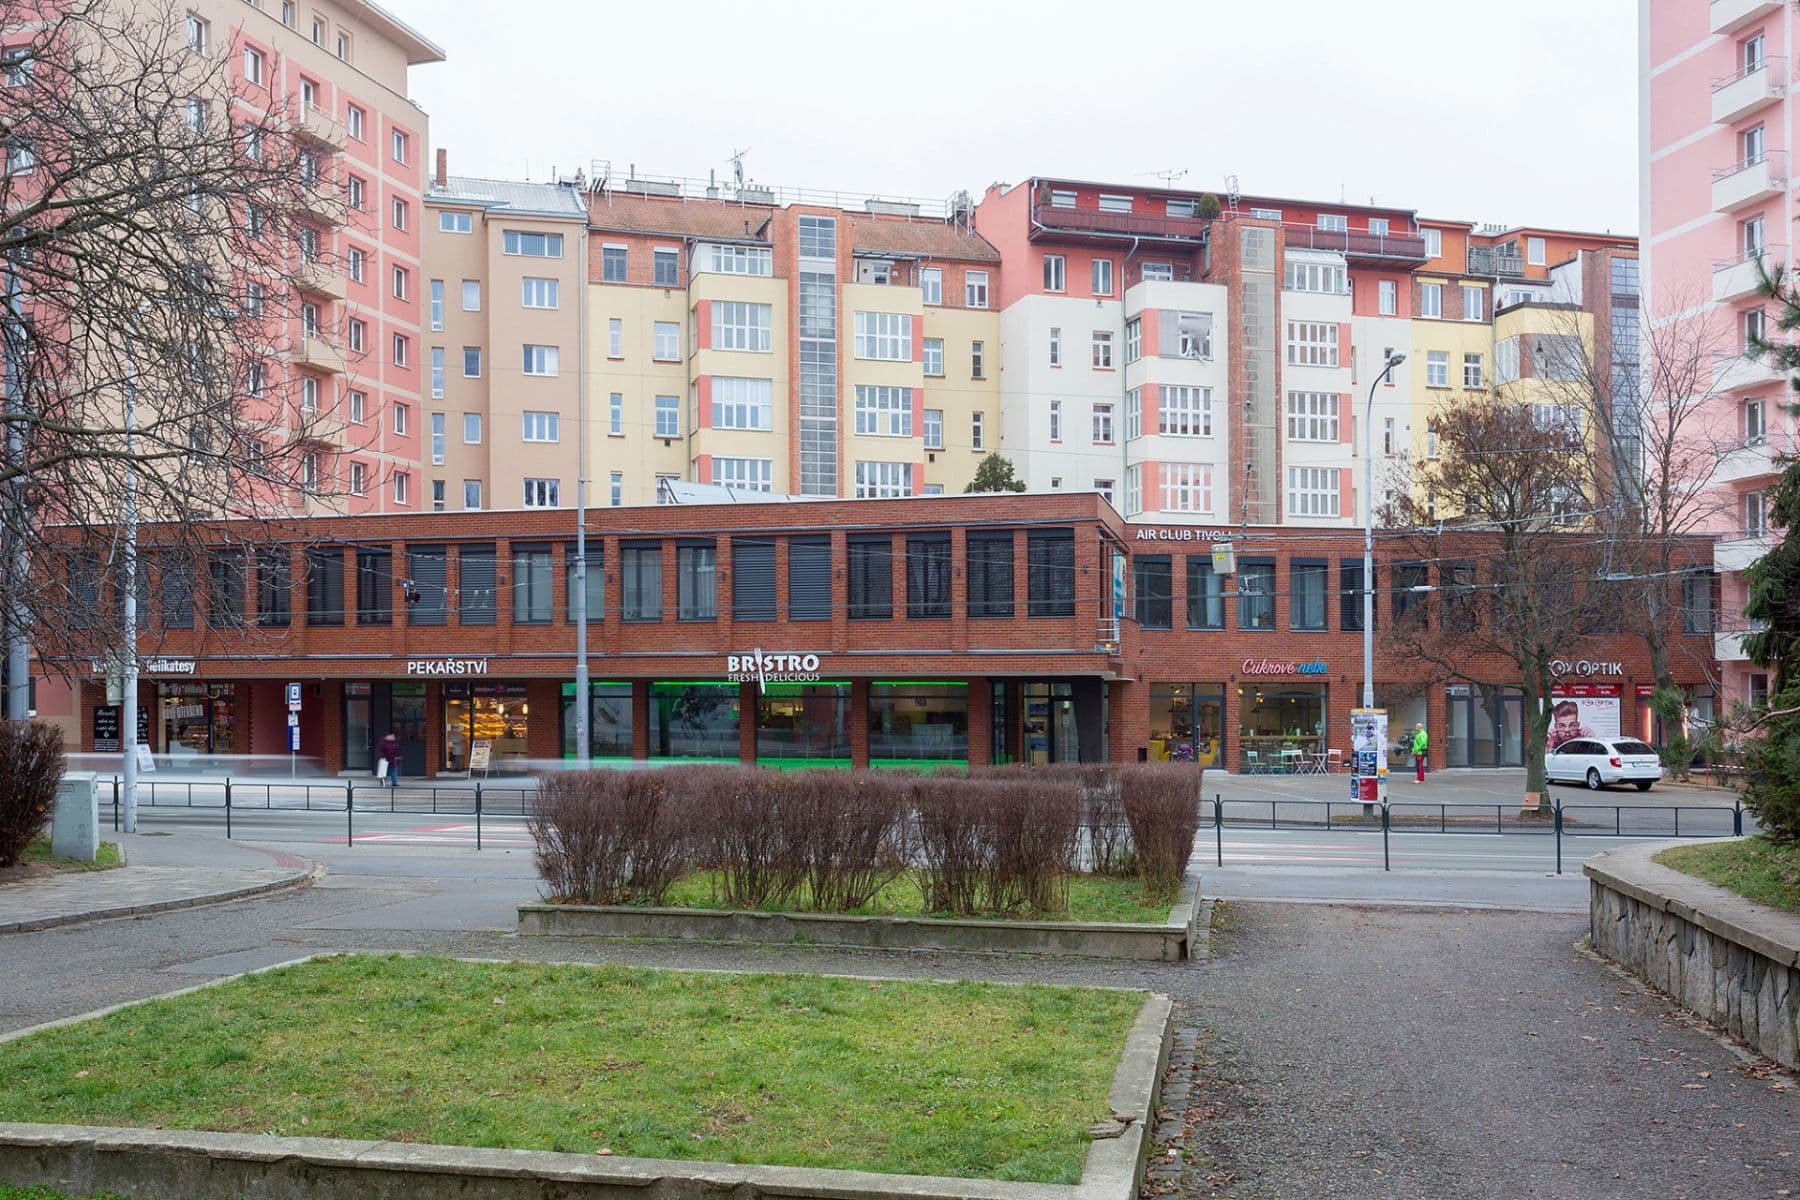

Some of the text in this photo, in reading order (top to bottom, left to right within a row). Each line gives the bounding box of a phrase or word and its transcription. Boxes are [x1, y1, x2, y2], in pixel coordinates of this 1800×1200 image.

[1136, 529, 1157, 540] AIR
[1159, 529, 1192, 541] CLUB
[407, 658, 487, 674] PEKAŘSTVÍ
[1242, 657, 1328, 675] Cukrové nebe
[1576, 660, 1623, 678] OPTIK
[727, 672, 820, 682] FRESH DELICIOUS
